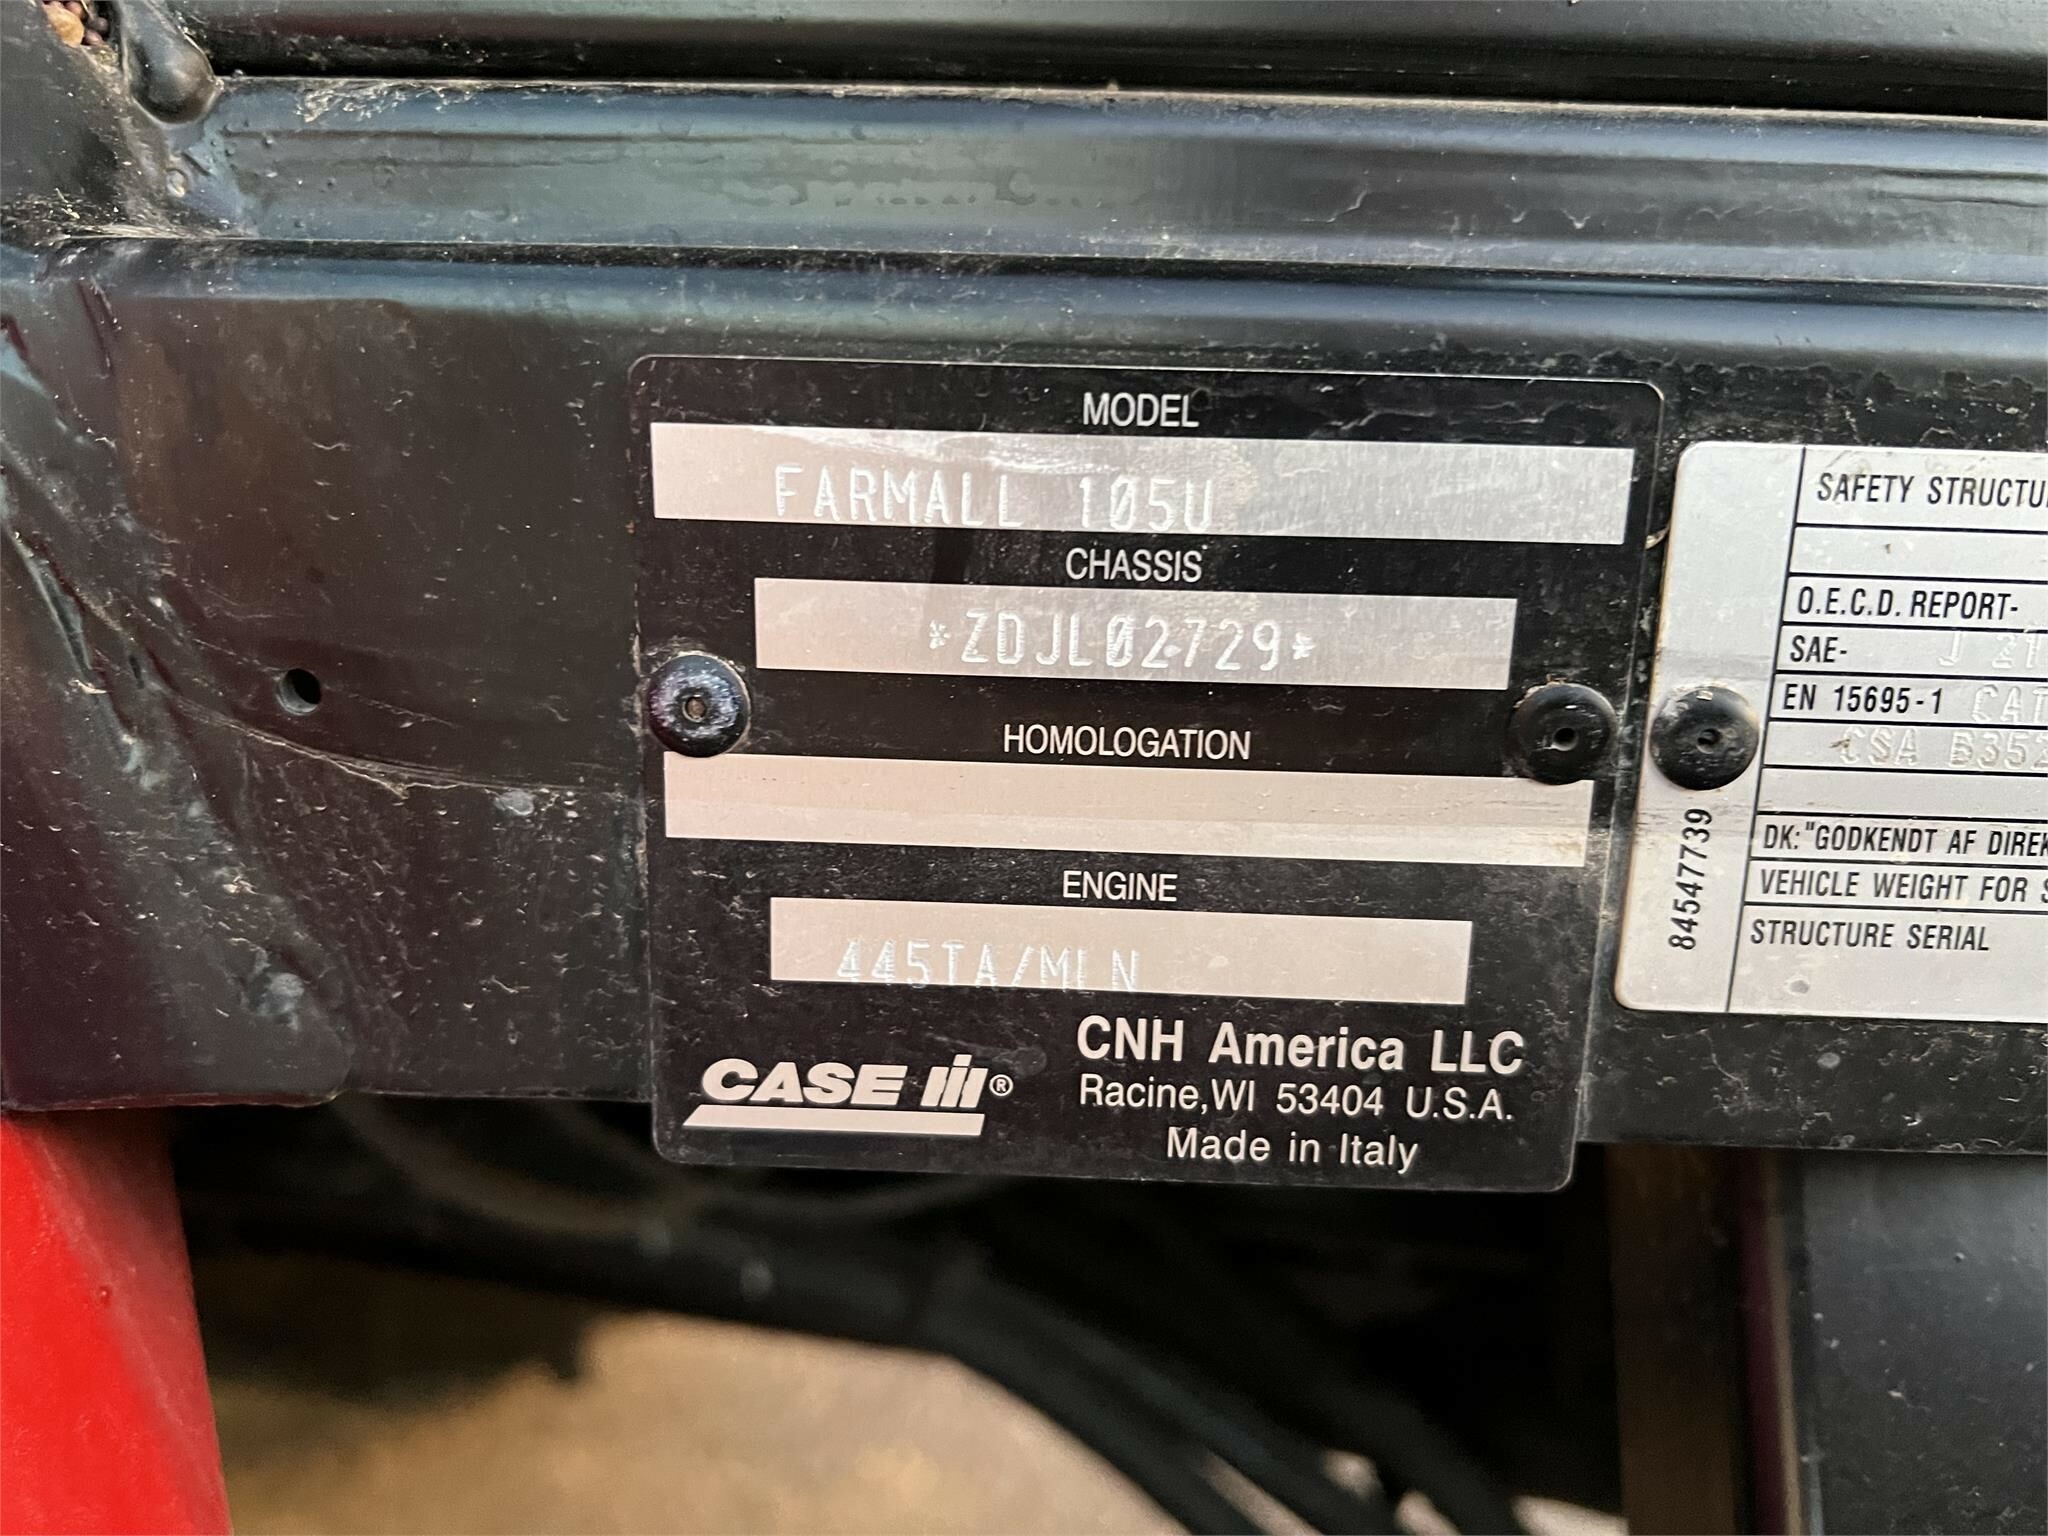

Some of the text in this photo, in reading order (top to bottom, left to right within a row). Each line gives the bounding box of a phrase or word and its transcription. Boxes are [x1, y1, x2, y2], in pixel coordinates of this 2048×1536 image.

[1083, 392, 1199, 429] MODEL
[773, 464, 1216, 533] FARMALL 105U
[1817, 471, 2048, 508] SAFETY STRUCTU
[1064, 547, 1203, 584] CHASSIS
[1910, 591, 2018, 620] REPORT-
[1790, 636, 1847, 663] SAE-
[1783, 684, 1817, 710] EN
[1832, 685, 1943, 714] 15695-1
[1003, 723, 1251, 760] HOMOLOGATION
[1839, 727, 1920, 766] CSA
[1946, 829, 1977, 854] AF
[1062, 870, 1178, 902] ENGINE
[1668, 809, 1713, 950] 84547739
[1760, 869, 1859, 896] VEHICLE
[1873, 873, 1968, 900] WEIGHT
[1980, 875, 2028, 902] FOR
[1750, 918, 1990, 951] STRUCTURE SERIAL
[1076, 1016, 1525, 1074] CNH America LLC
[701, 1058, 908, 1106] CASE
[1275, 1083, 1384, 1116] 53404
[1405, 1086, 1515, 1121] U.S.A.
[1166, 1127, 1419, 1174] Made in Italy
